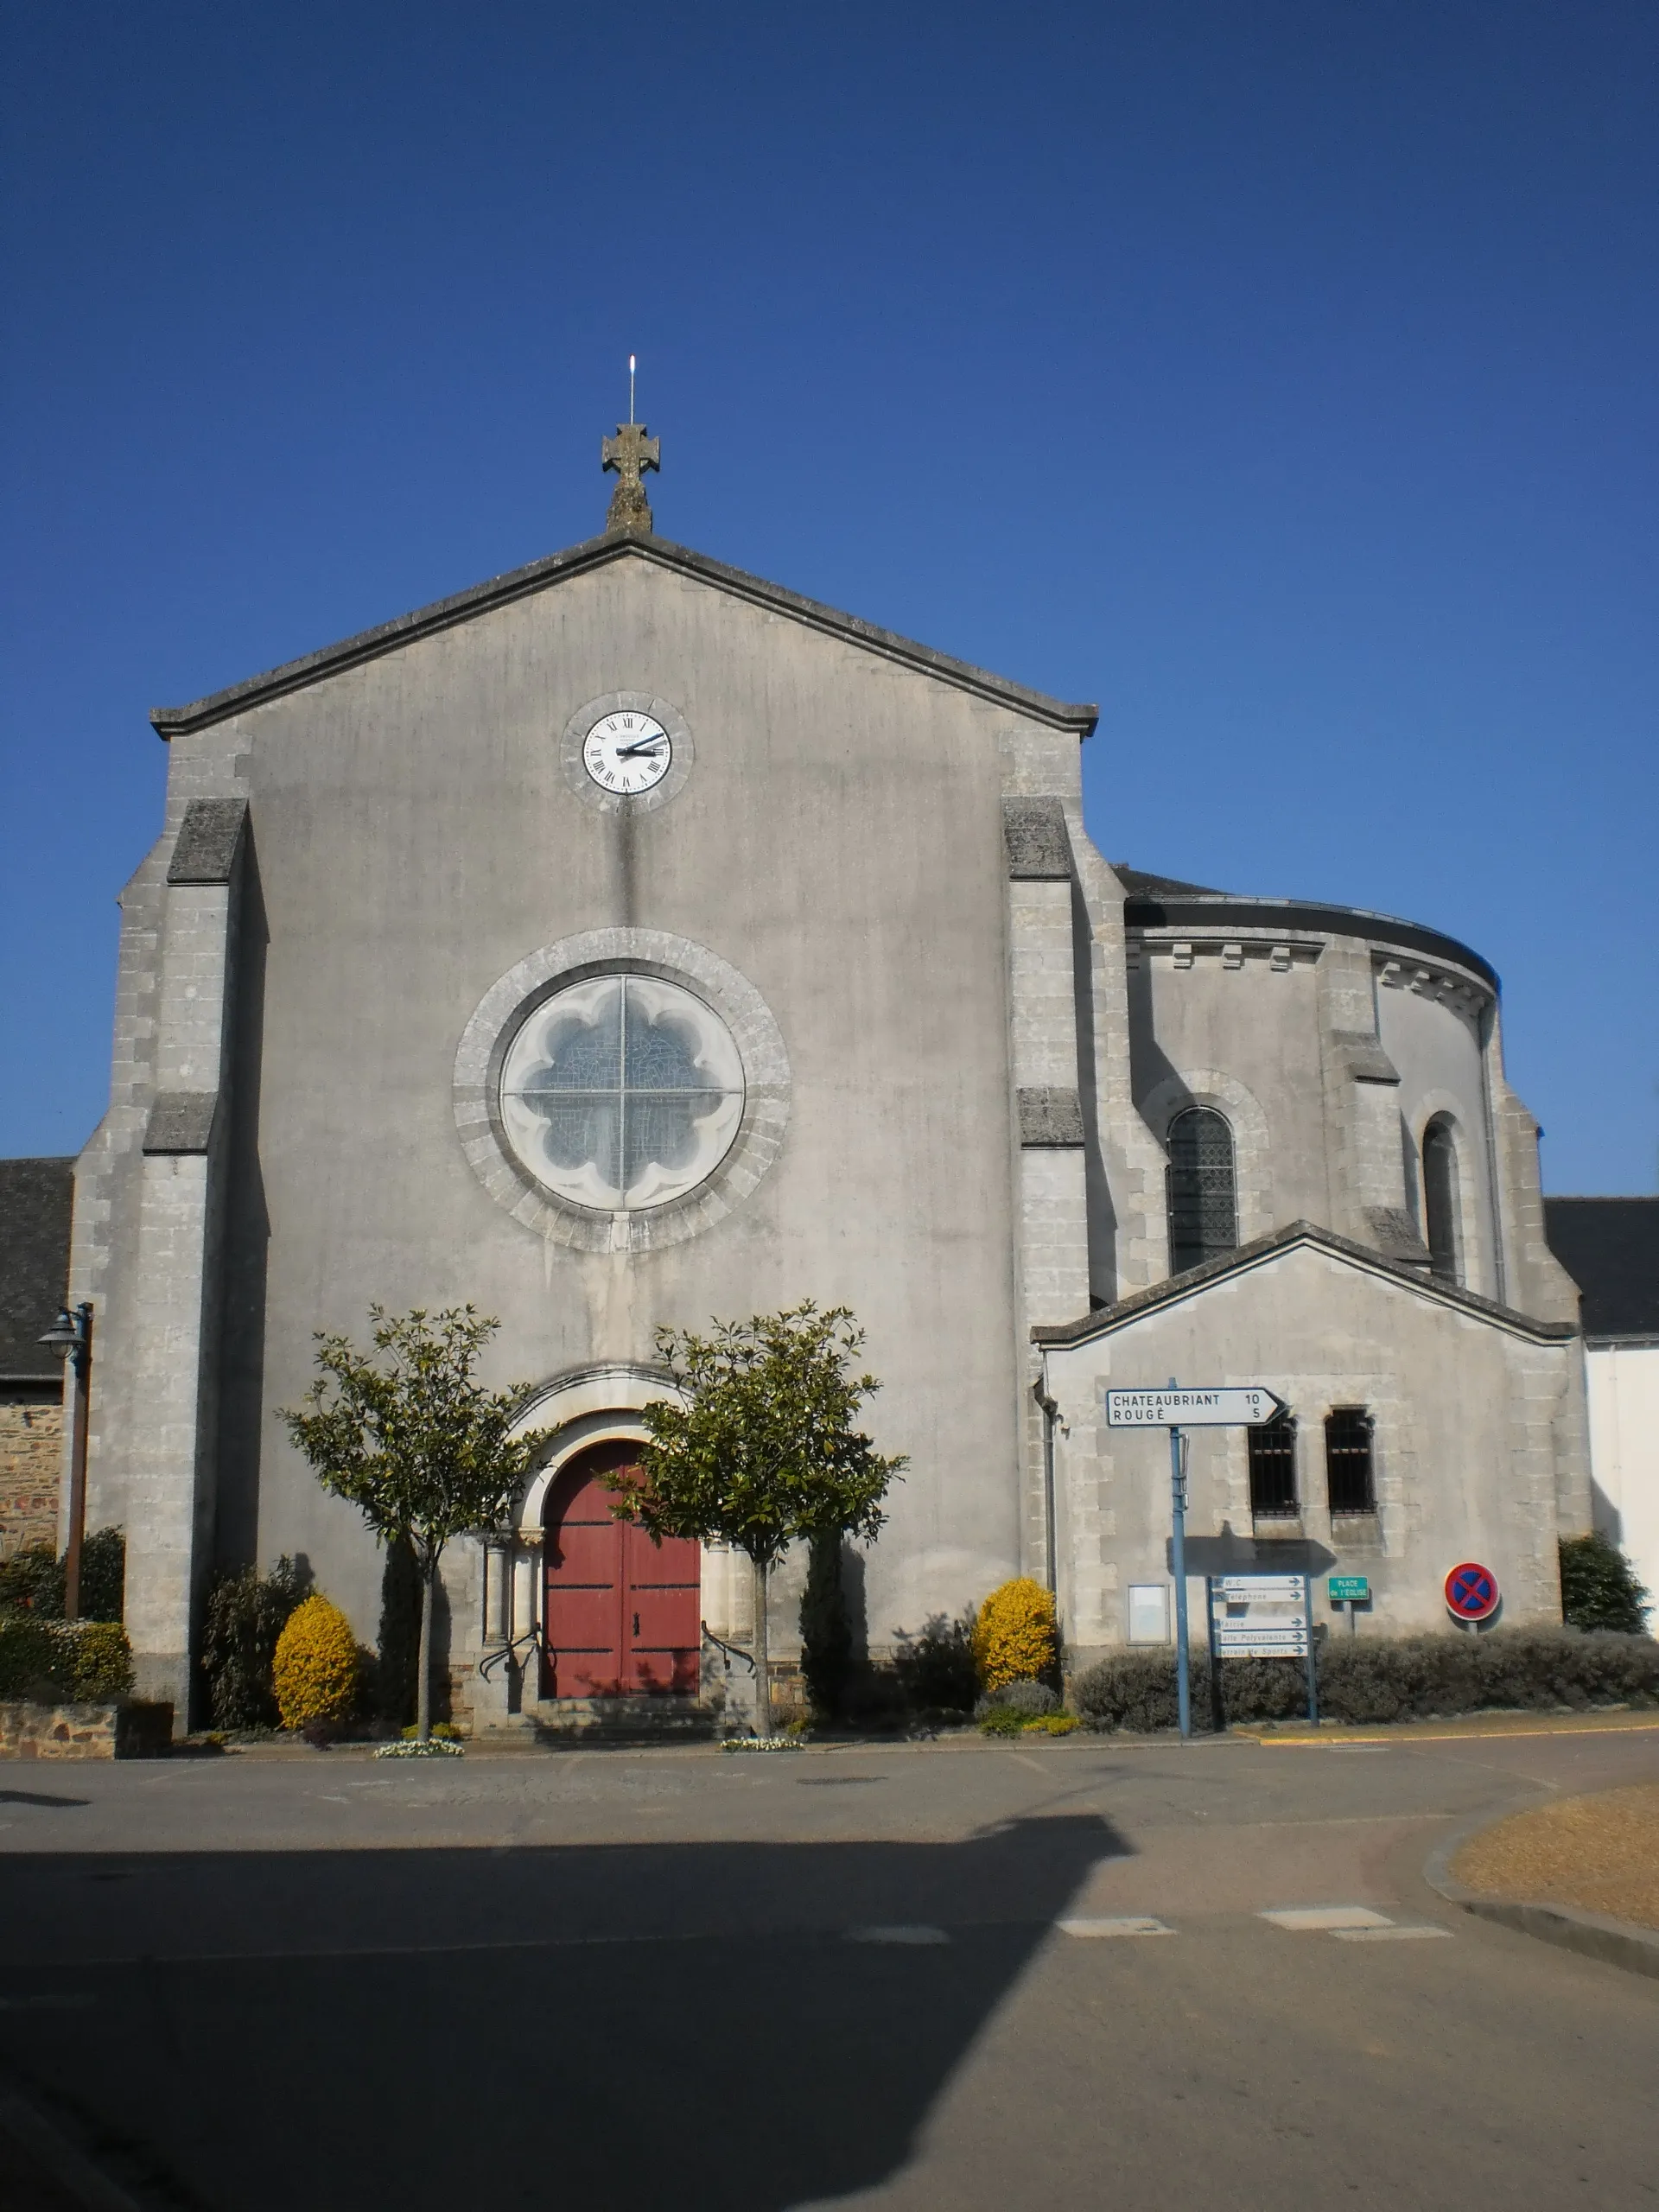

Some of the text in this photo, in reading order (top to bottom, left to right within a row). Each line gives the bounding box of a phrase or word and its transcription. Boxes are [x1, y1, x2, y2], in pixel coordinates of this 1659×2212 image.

[1114, 1394, 1260, 1407] CHATEAUBRIANT 10
[1114, 1408, 1260, 1421] ROUGÉ 5
